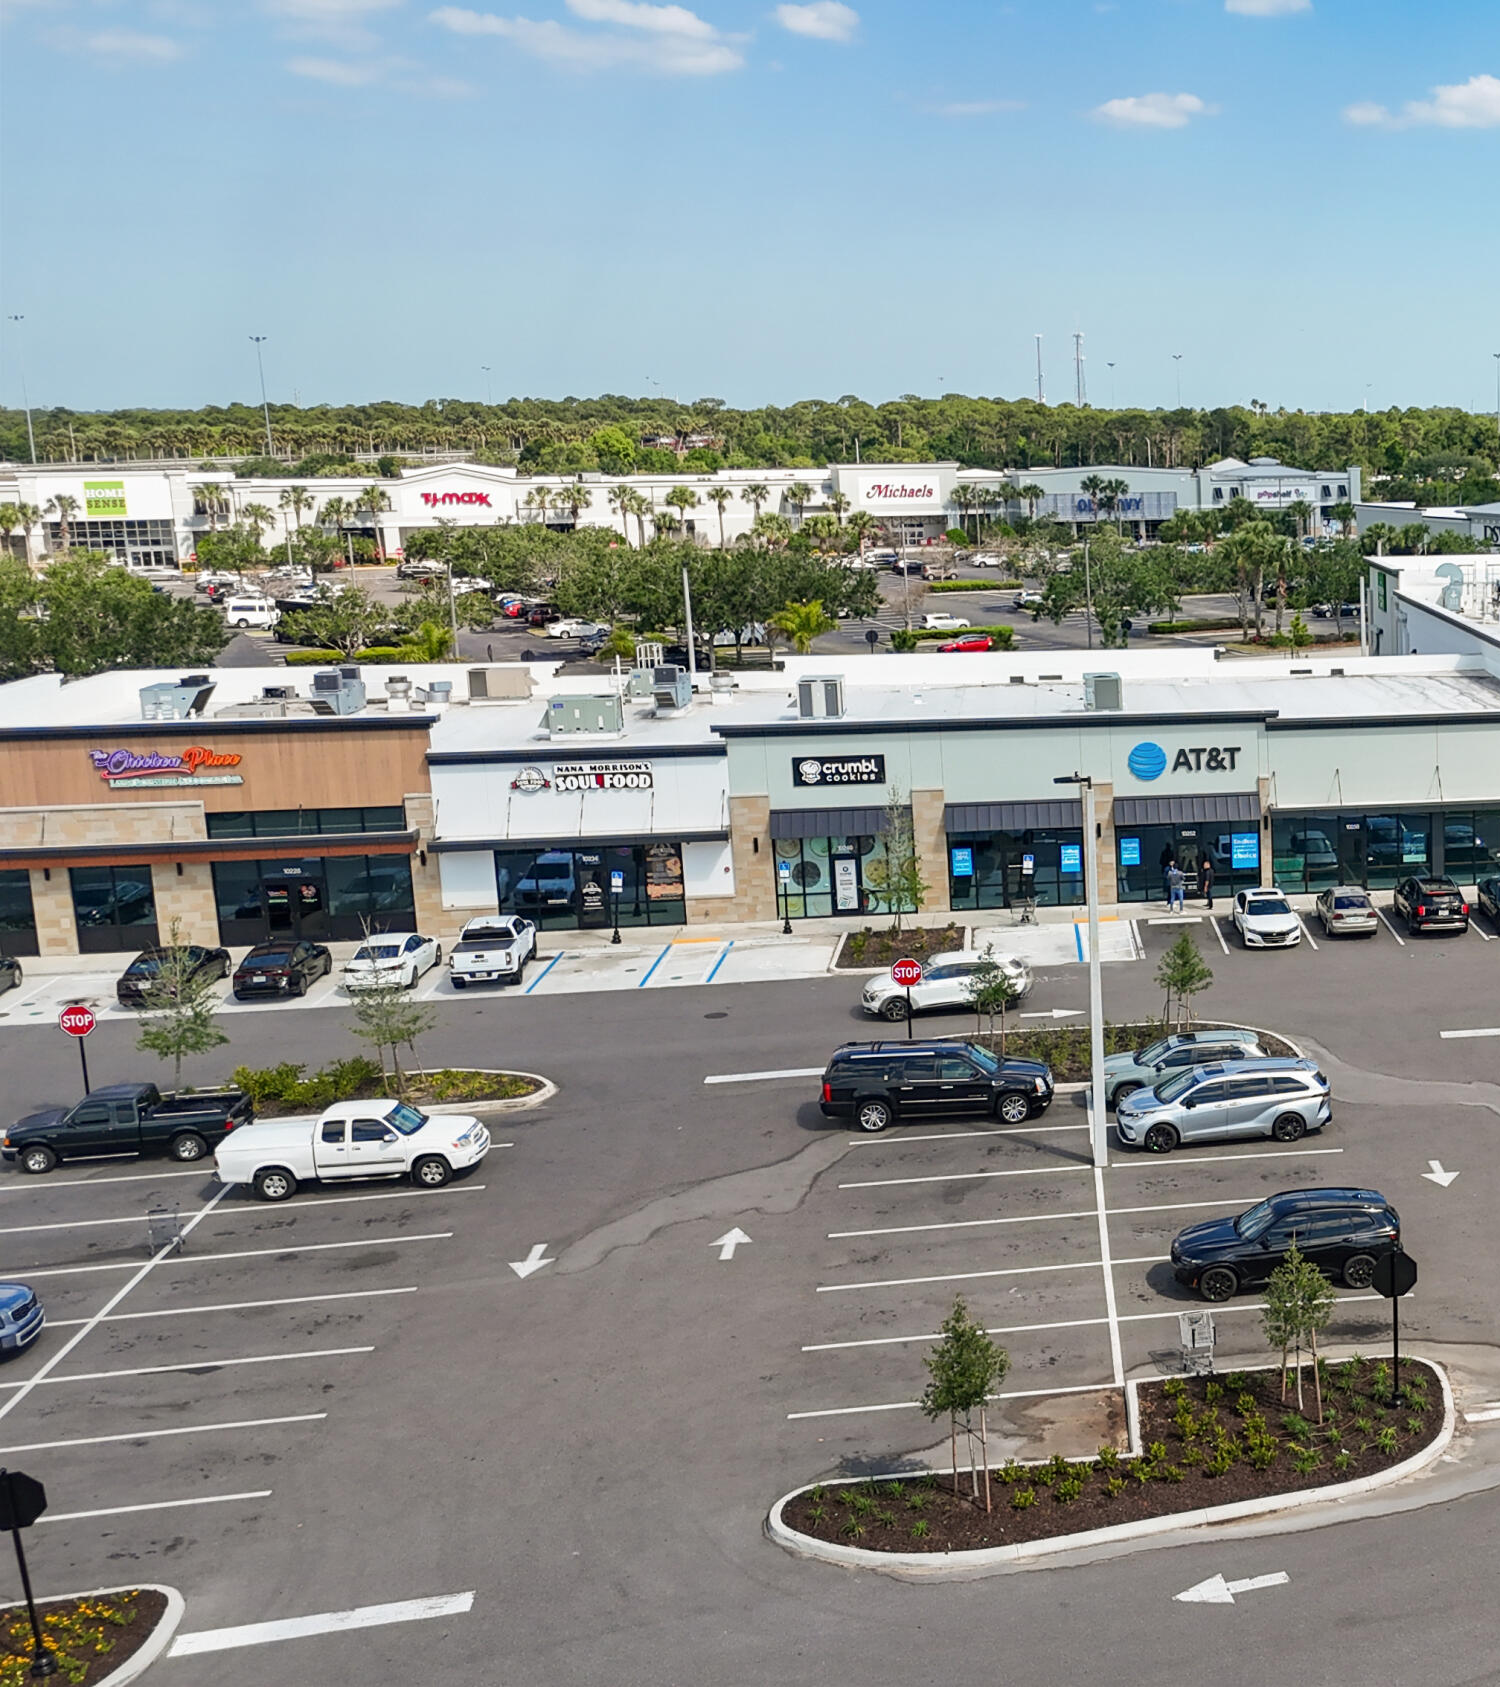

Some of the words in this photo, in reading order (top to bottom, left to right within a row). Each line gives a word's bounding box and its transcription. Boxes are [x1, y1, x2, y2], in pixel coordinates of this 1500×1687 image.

[86, 489, 125, 498] HOME
[866, 484, 933, 499] Michaels
[87, 499, 126, 509] SENSE
[107, 750, 182, 774] Chicken
[183, 746, 241, 774] Place
[1173, 747, 1241, 771] AT&T
[590, 763, 650, 772] MORRISON'S
[823, 759, 879, 774] crumbl
[556, 774, 600, 791] SOUL
[603, 773, 652, 788] FOOD
[826, 773, 876, 782] cookies
[894, 967, 921, 978] STOP
[63, 1014, 93, 1028] STOP
